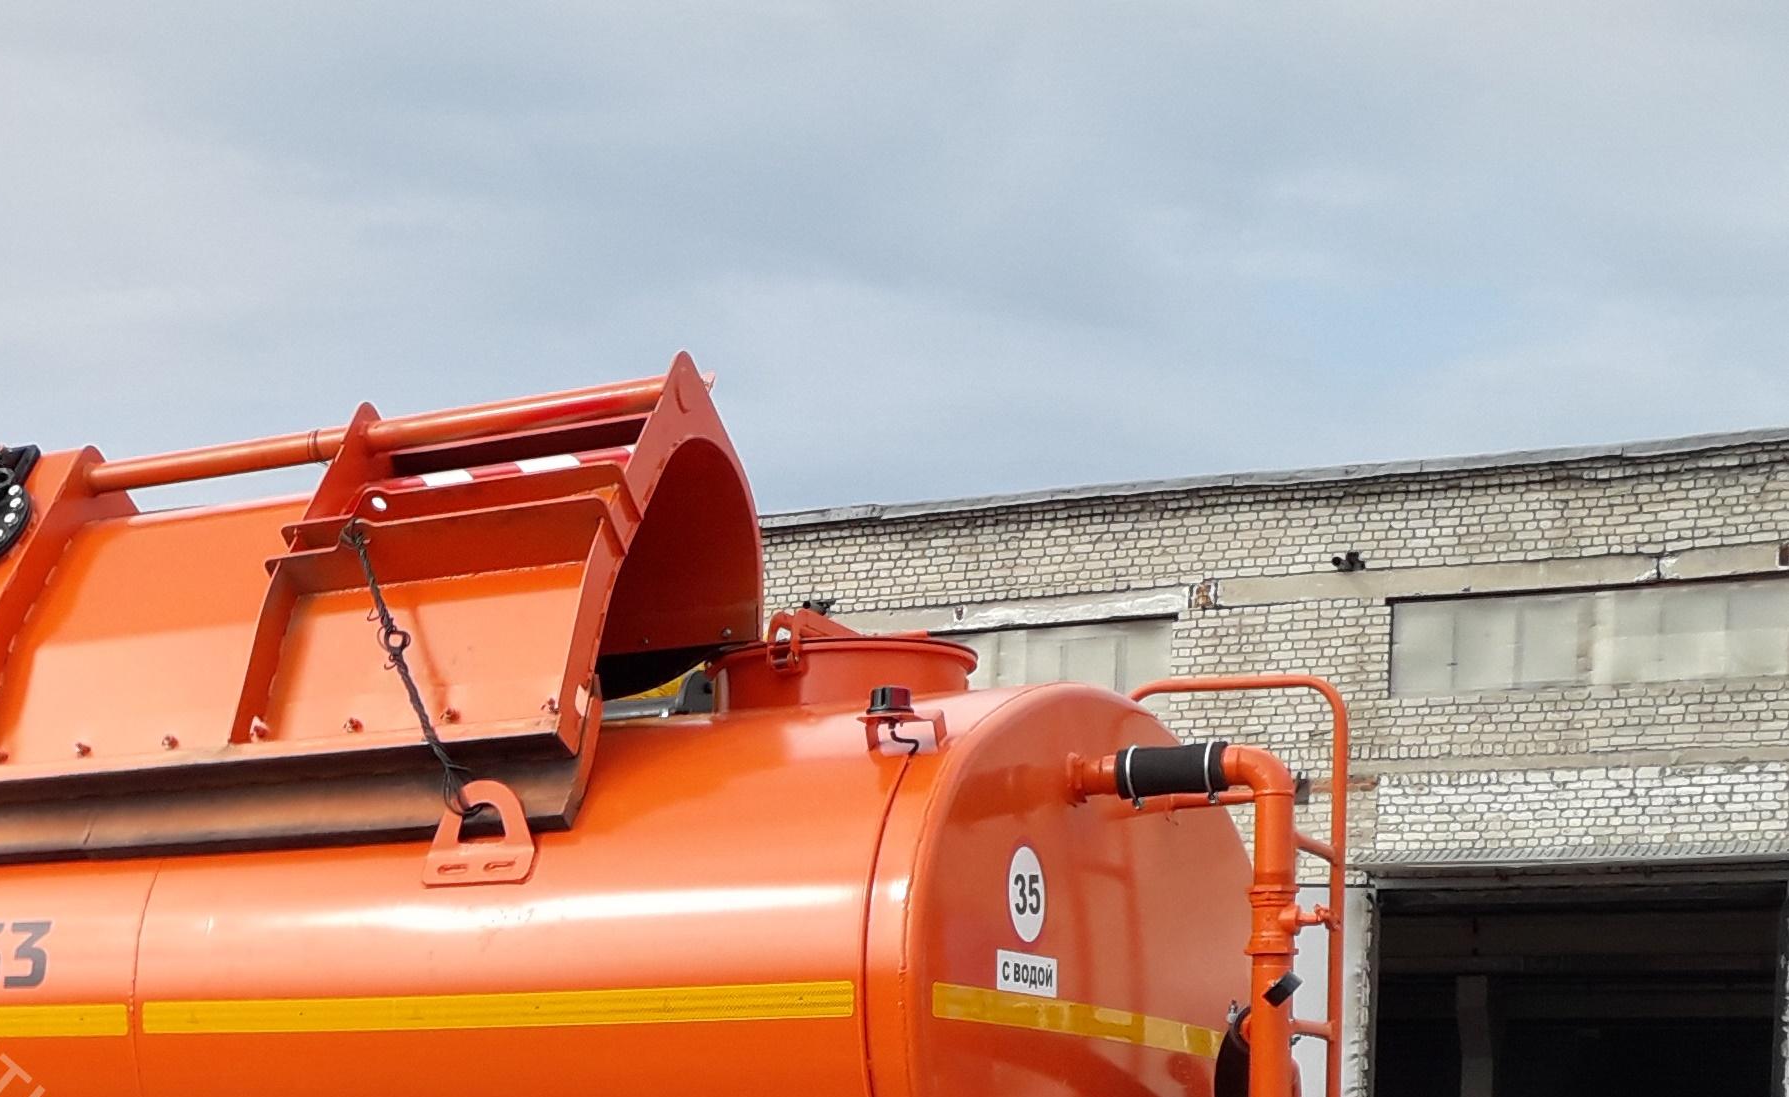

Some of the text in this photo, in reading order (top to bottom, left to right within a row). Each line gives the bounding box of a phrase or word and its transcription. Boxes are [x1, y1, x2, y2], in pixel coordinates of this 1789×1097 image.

[1014, 873, 1040, 915] 35
[1002, 960, 1053, 989] С ВОДОЙ
